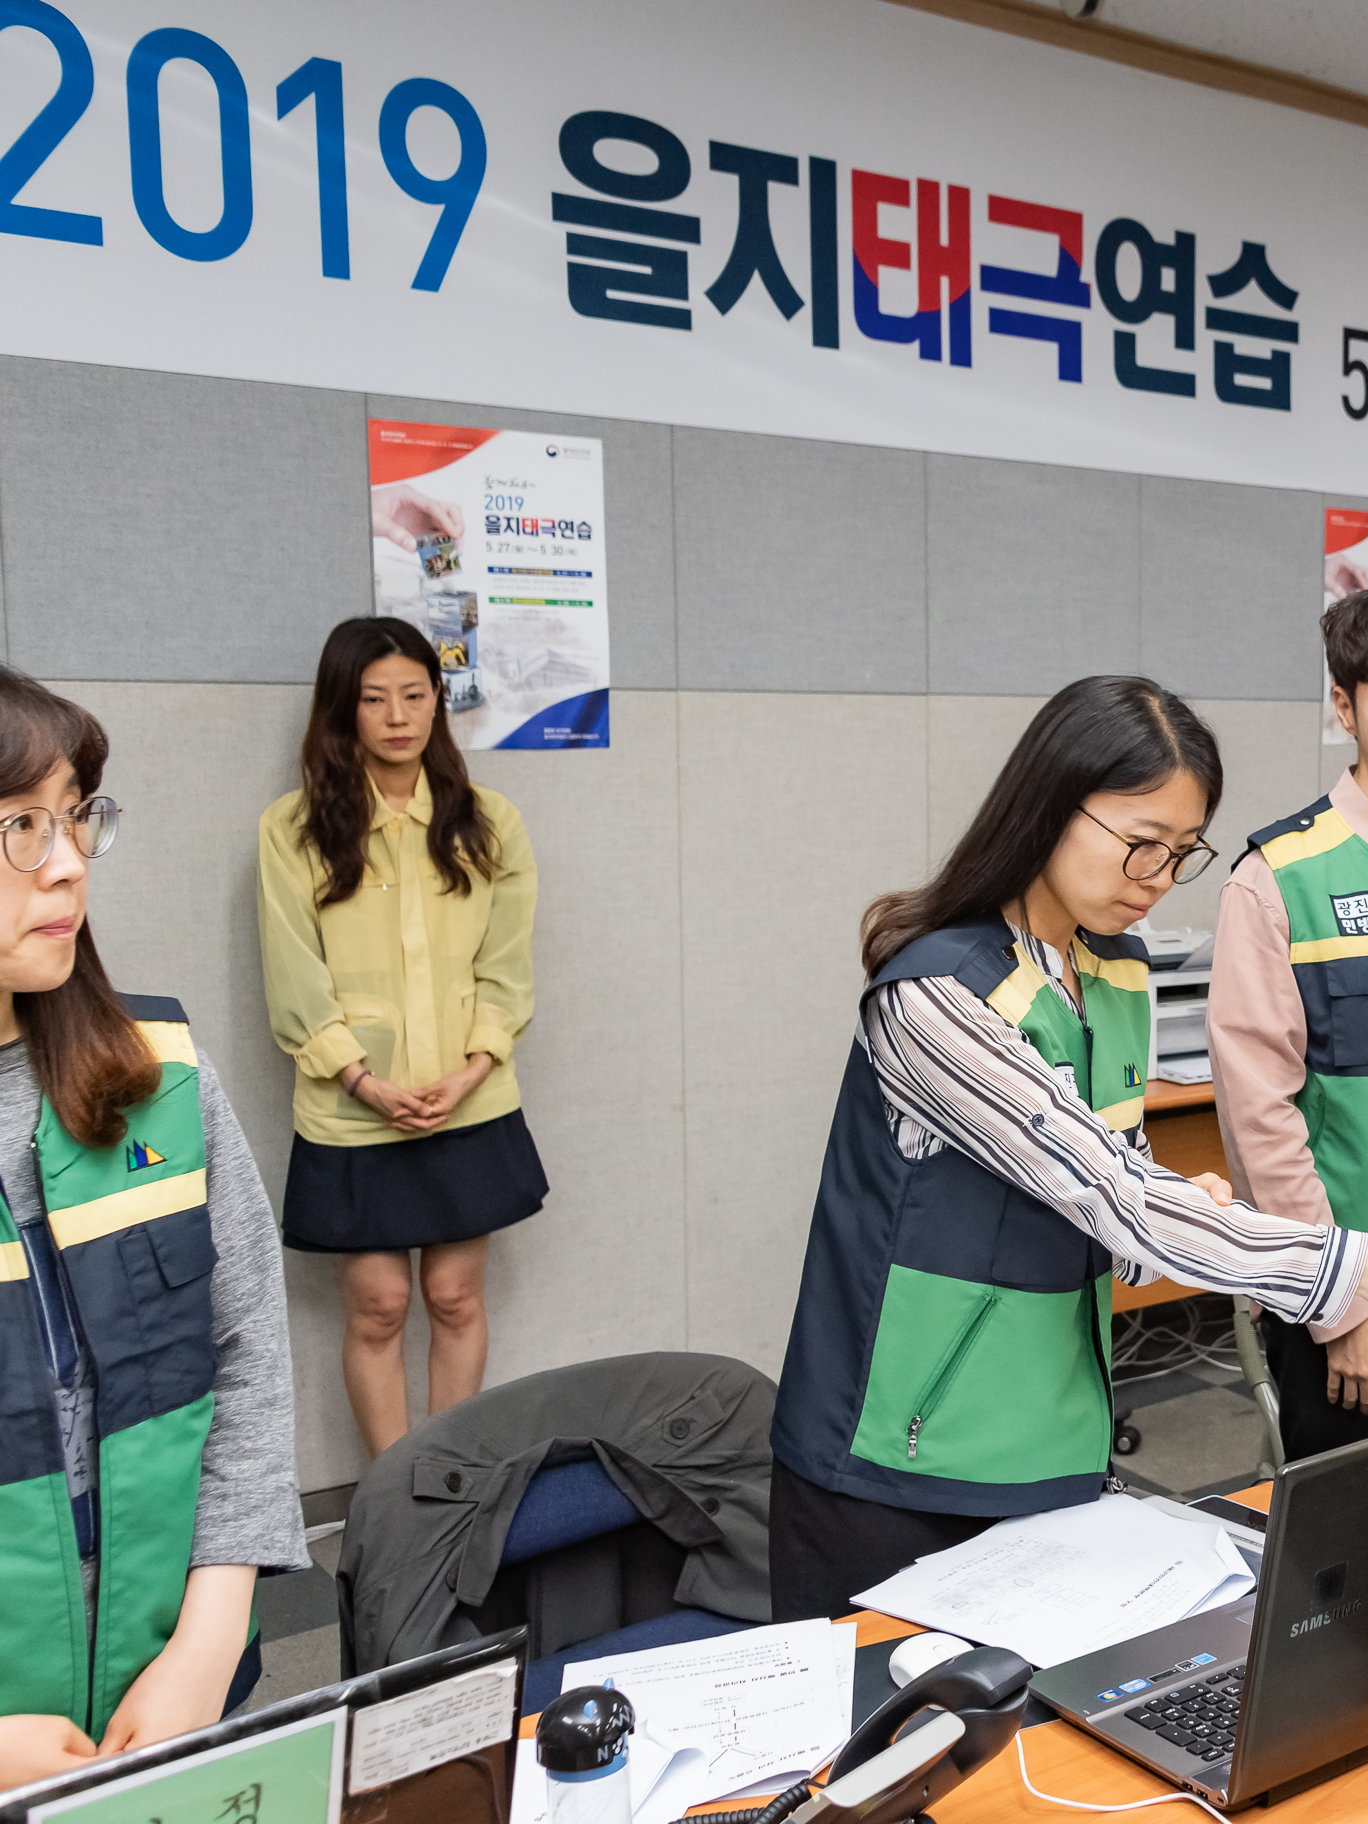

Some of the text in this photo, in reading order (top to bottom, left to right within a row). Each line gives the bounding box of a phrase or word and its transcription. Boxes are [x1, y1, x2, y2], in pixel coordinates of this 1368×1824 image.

[0, 0, 488, 293] 2019
[551, 108, 1301, 412] 을지태극연습
[484, 493, 525, 512] 2019
[484, 514, 592, 541] 을지태극연습
[1290, 1599, 1362, 1638] SAMSUNG
